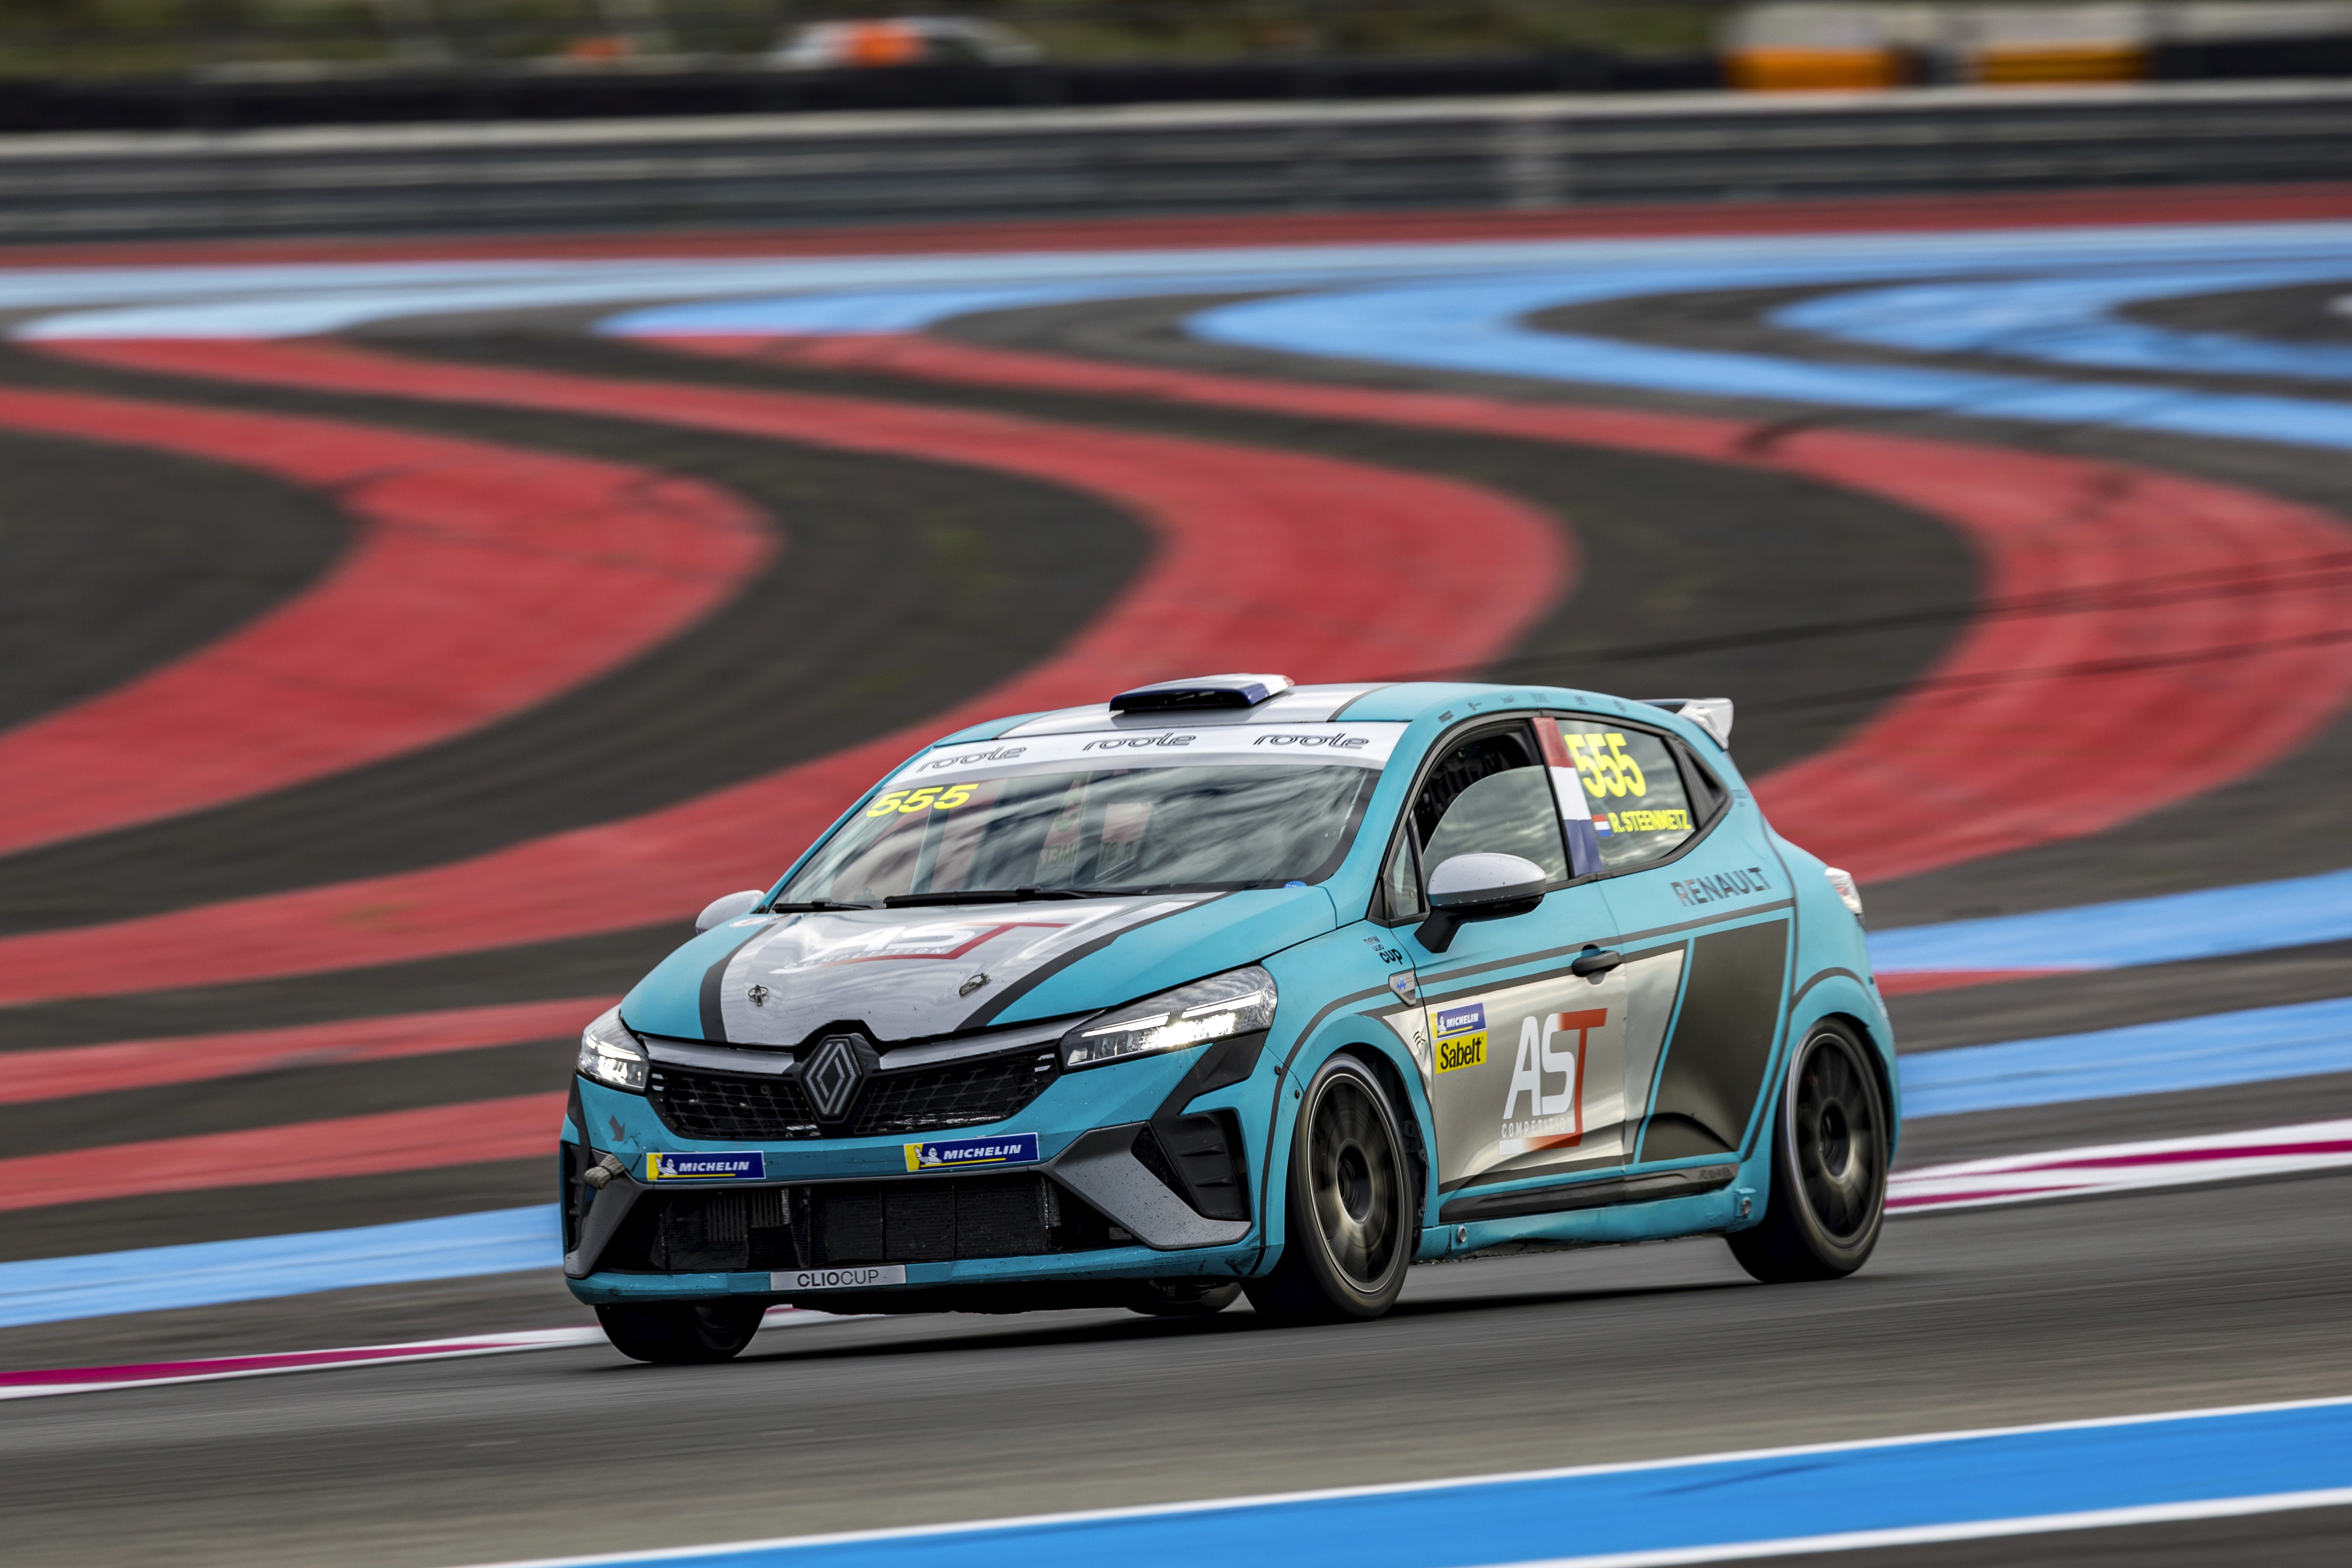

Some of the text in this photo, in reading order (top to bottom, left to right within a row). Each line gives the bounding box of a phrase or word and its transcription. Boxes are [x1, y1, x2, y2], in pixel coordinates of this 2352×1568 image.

[1563, 733, 1646, 798] 555
[866, 783, 979, 817] 555
[1608, 810, 1692, 833] R.STEENMETZ
[1670, 867, 1772, 907] RENAULT
[1363, 936, 1380, 945] new
[785, 948, 946, 969] COMPETITION
[1379, 949, 1403, 965] cup
[1446, 1013, 1479, 1028] MICHELIN
[1440, 1036, 1482, 1070] Sabelt
[1501, 1008, 1608, 1147] AST
[1502, 1116, 1574, 1138] COMPETITION
[943, 1144, 1022, 1160] MICHELIN
[678, 1161, 750, 1172] MICHELIN
